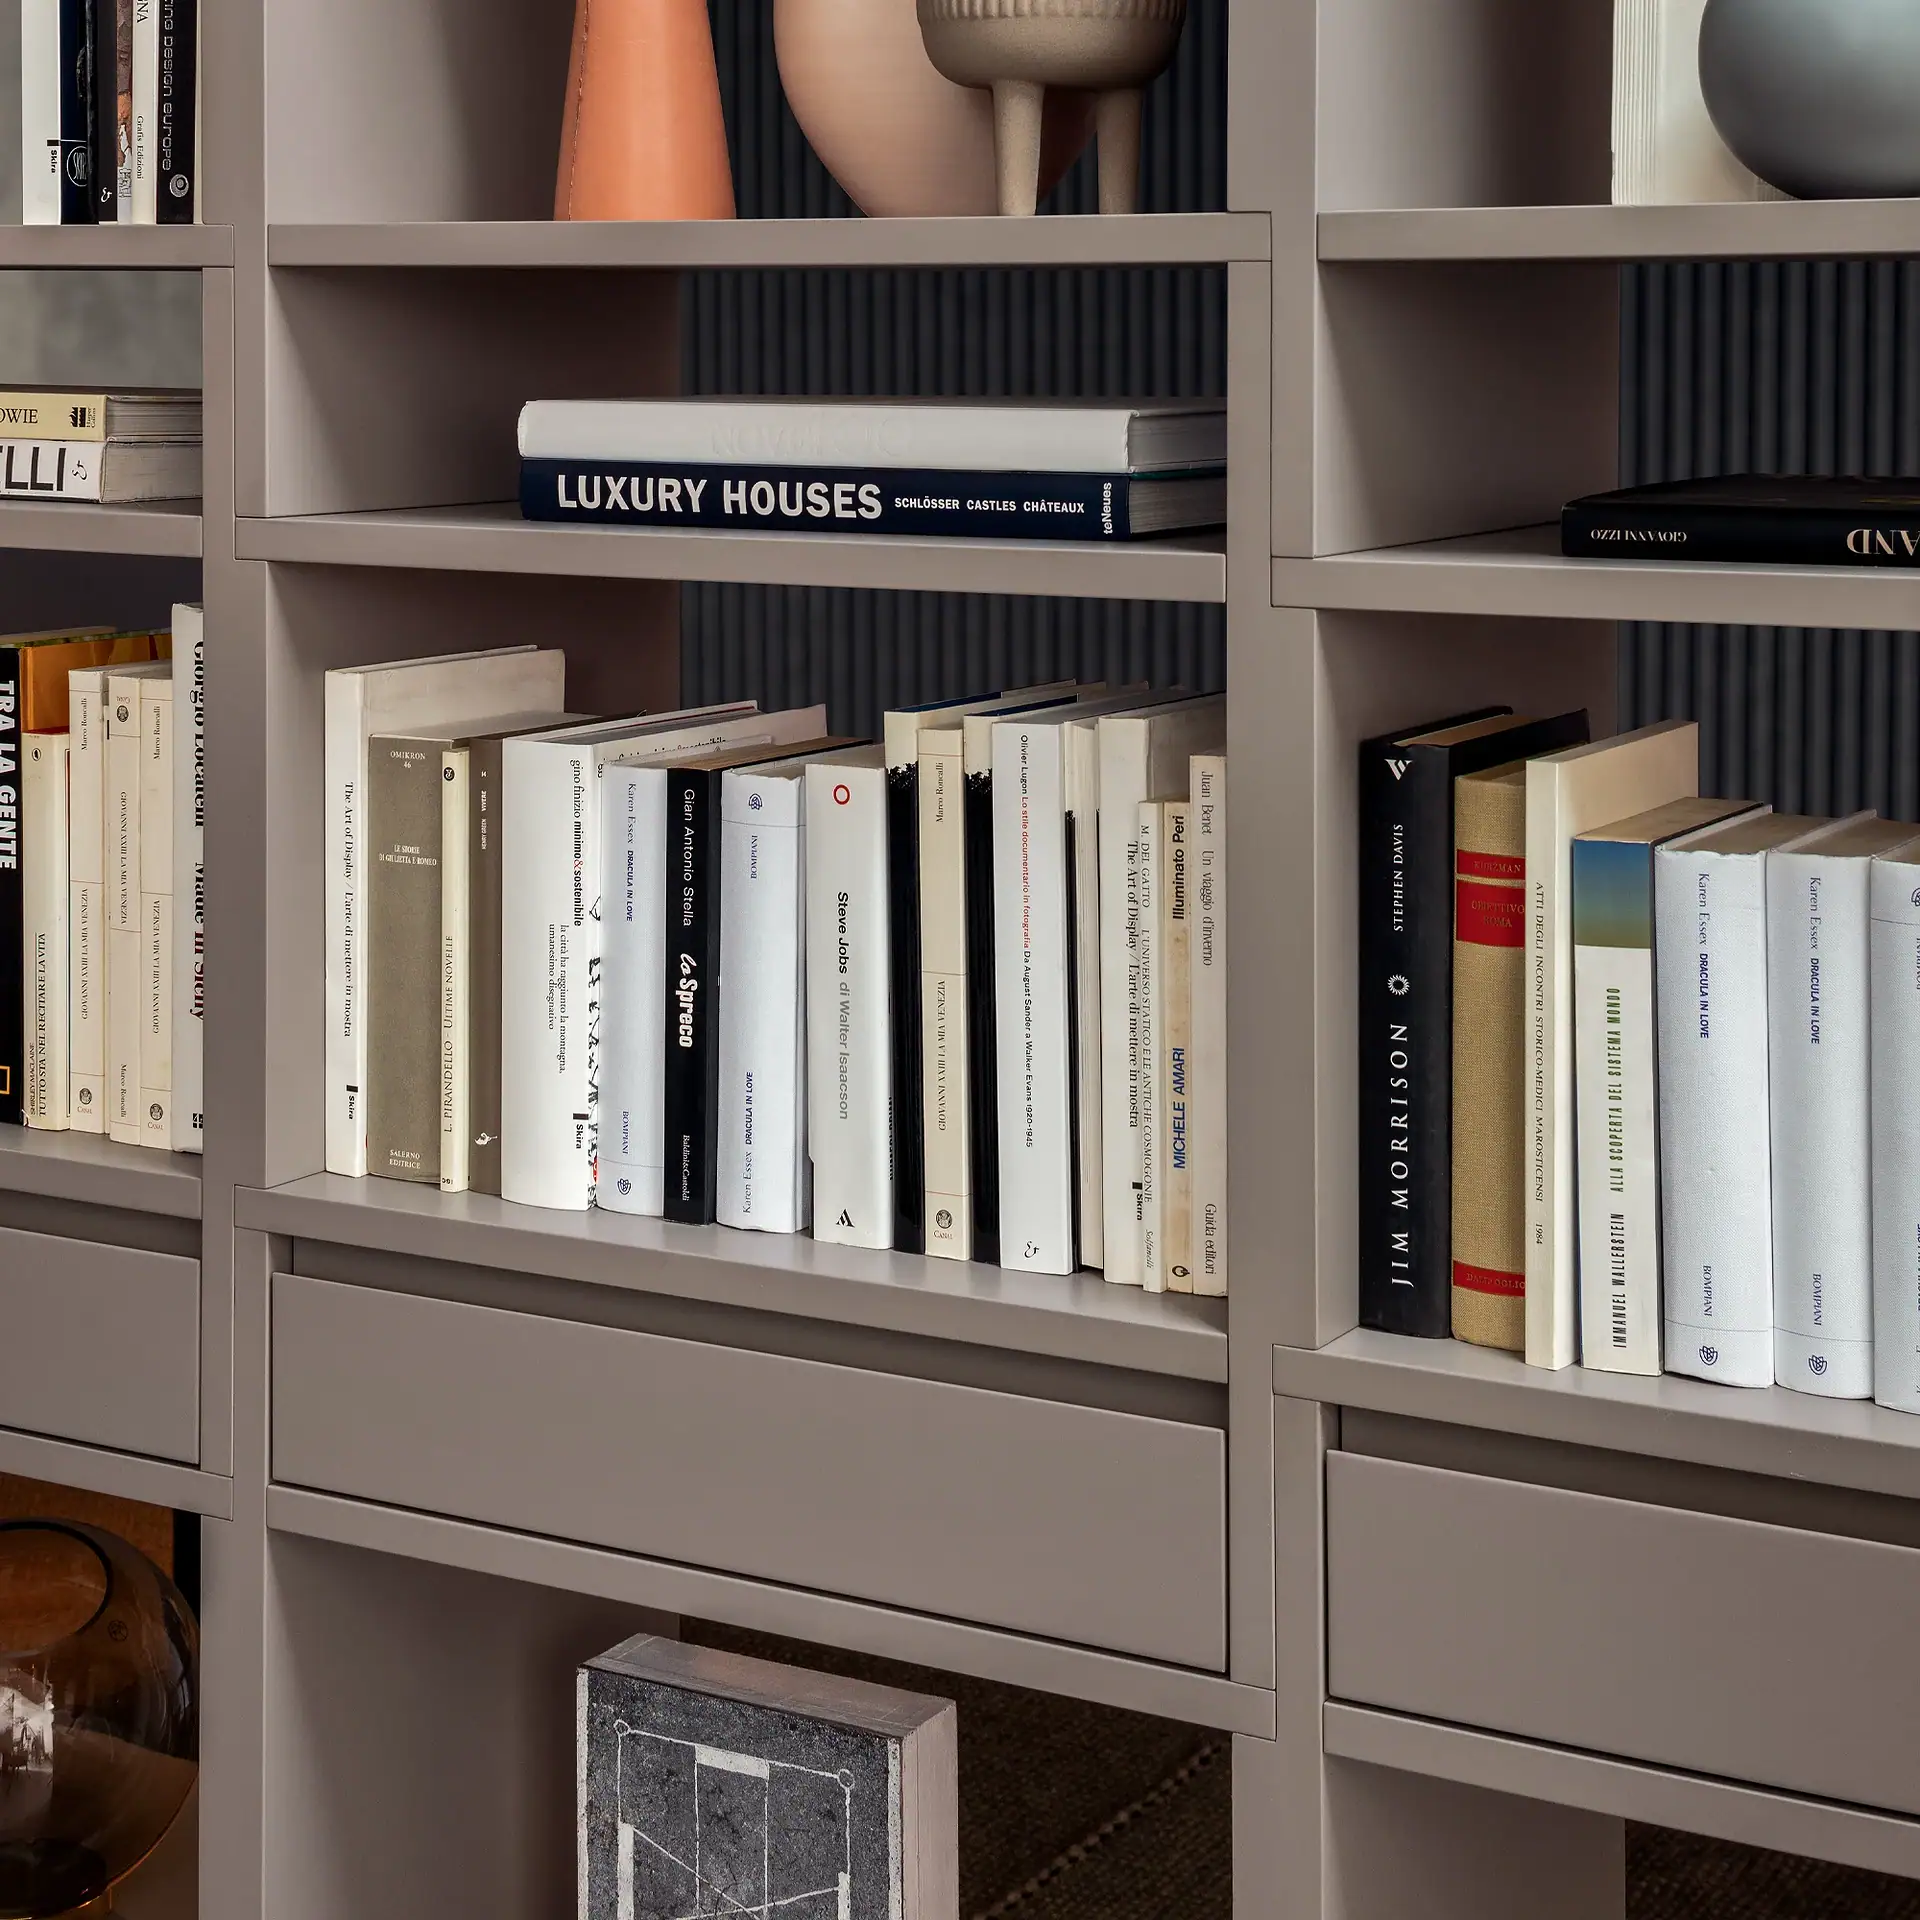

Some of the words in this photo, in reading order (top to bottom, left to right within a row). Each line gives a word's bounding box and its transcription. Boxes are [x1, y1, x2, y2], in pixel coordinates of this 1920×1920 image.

[0, 446, 66, 491] LLI
[558, 475, 707, 512] LUXURY
[724, 480, 882, 519] HOUSES
[895, 496, 959, 509] SCHLÖSSER
[967, 500, 1016, 511] CASTLES
[1024, 499, 1084, 513] CHÂTEAUX
[1103, 482, 1112, 534] teNeues
[1591, 530, 1620, 540] IZZO
[1626, 531, 1687, 541] GIOVANNI
[0, 680, 16, 731] TRA
[0, 743, 16, 774] LA
[391, 750, 425, 760] OMIKRON
[570, 760, 583, 783] gino
[345, 782, 353, 803] The
[1020, 767, 1028, 794] Lugon
[1202, 771, 1213, 797] Juan
[574, 786, 585, 818] finizio
[684, 789, 694, 820] Gian
[1021, 797, 1028, 808] Lo
[0, 785, 16, 870] GENTE
[345, 827, 353, 838] of
[1172, 816, 1184, 843] Peri
[1202, 804, 1214, 835] Benet
[344, 842, 353, 879] Display
[684, 827, 694, 881] Antonio
[1128, 841, 1138, 864] The
[1141, 843, 1149, 863] DEL
[1202, 851, 1214, 865] Un
[1394, 825, 1403, 863] DAVIS
[574, 821, 584, 926] minimo&sostenibile
[1128, 868, 1138, 888] Art
[1141, 868, 1150, 907] GATTO
[1173, 849, 1185, 919] Illuminato
[1699, 873, 1709, 907] Karen
[345, 893, 353, 922] L'arte
[683, 887, 694, 926] Stella
[1023, 895, 1030, 903] in
[1128, 892, 1138, 904] of
[1200, 873, 1214, 910] viaggio
[1394, 871, 1403, 931] STEPHEN
[1810, 878, 1821, 911] Karen
[838, 892, 848, 934] Steve
[1021, 906, 1030, 948] fotografia
[1126, 908, 1139, 950] Display
[1699, 913, 1710, 945] Essex
[37, 932, 47, 957] VITA
[345, 926, 353, 936] di
[1203, 917, 1214, 965] d'inverno
[1810, 917, 1821, 949] Essex
[37, 958, 47, 974] LA
[443, 935, 453, 983] NOVELLE
[549, 924, 557, 976] umanesimo
[561, 957, 569, 967] ha
[680, 954, 696, 976] lo
[839, 938, 849, 973] Jobs
[1142, 930, 1151, 995] L'UNIVERSO
[346, 986, 353, 995] in
[556, 970, 568, 1013] raggiunto
[840, 982, 850, 996] di
[1023, 966, 1031, 996] August
[1128, 965, 1140, 999] L'arte
[1700, 954, 1709, 996] DRACULA
[1811, 958, 1819, 1002] DRACULA
[37, 976, 47, 1030] RECITARE
[443, 987, 453, 1028] ULTIME
[546, 980, 557, 1030] disegnativo
[676, 978, 697, 1047] Spreco
[1129, 1003, 1140, 1014] di
[1606, 989, 1620, 1023] MONDO
[1700, 1001, 1708, 1010] IN
[1811, 1005, 1819, 1016] IN
[840, 1000, 849, 1048] Walter
[1142, 998, 1151, 1046] STATICO
[1700, 1014, 1708, 1038] LOVE
[1811, 1020, 1819, 1044] LOVE
[37, 1032, 47, 1054] NEL
[557, 1026, 565, 1073] montagna,
[938, 1044, 945, 1056] LA
[1129, 1018, 1138, 1066] mettere
[1607, 1031, 1621, 1076] SISTEMA
[37, 1057, 47, 1077] STA
[443, 1041, 453, 1118] PIRANDELLO
[1130, 1069, 1140, 1081] in
[1142, 1057, 1151, 1069] LE
[1172, 1048, 1185, 1095] AMARI
[1536, 1016, 1544, 1110] STORICO-MEDICI
[37, 1079, 47, 1116] TUTTO
[840, 1052, 849, 1119] Isaacson
[1143, 1072, 1151, 1123] ANTICHE
[1608, 1084, 1622, 1100] DEL
[1130, 1085, 1139, 1127] mostra
[1390, 1024, 1408, 1209] MORRISON
[1172, 1101, 1185, 1168] MICHELE
[1609, 1108, 1623, 1160] SCOPERTA
[389, 1159, 420, 1169] EDITRICE
[390, 1149, 420, 1159] SALERNO
[682, 1135, 690, 1201] Baldini&Castoldi
[743, 1152, 753, 1179] Essex
[1142, 1125, 1152, 1203] COSMOGONIE
[1610, 1168, 1623, 1192] ALLA
[742, 1183, 752, 1214] Karen
[1205, 1204, 1216, 1236] Guida
[1144, 1230, 1153, 1268] Solfanelli
[1206, 1240, 1216, 1274] editori
[1392, 1232, 1414, 1287] JIM
[1611, 1214, 1625, 1285] WALLERSTEIN
[1702, 1266, 1713, 1316] BOMPIANI
[1813, 1274, 1822, 1325] BOMPIANI
[1612, 1294, 1626, 1348] IMMANUEL
